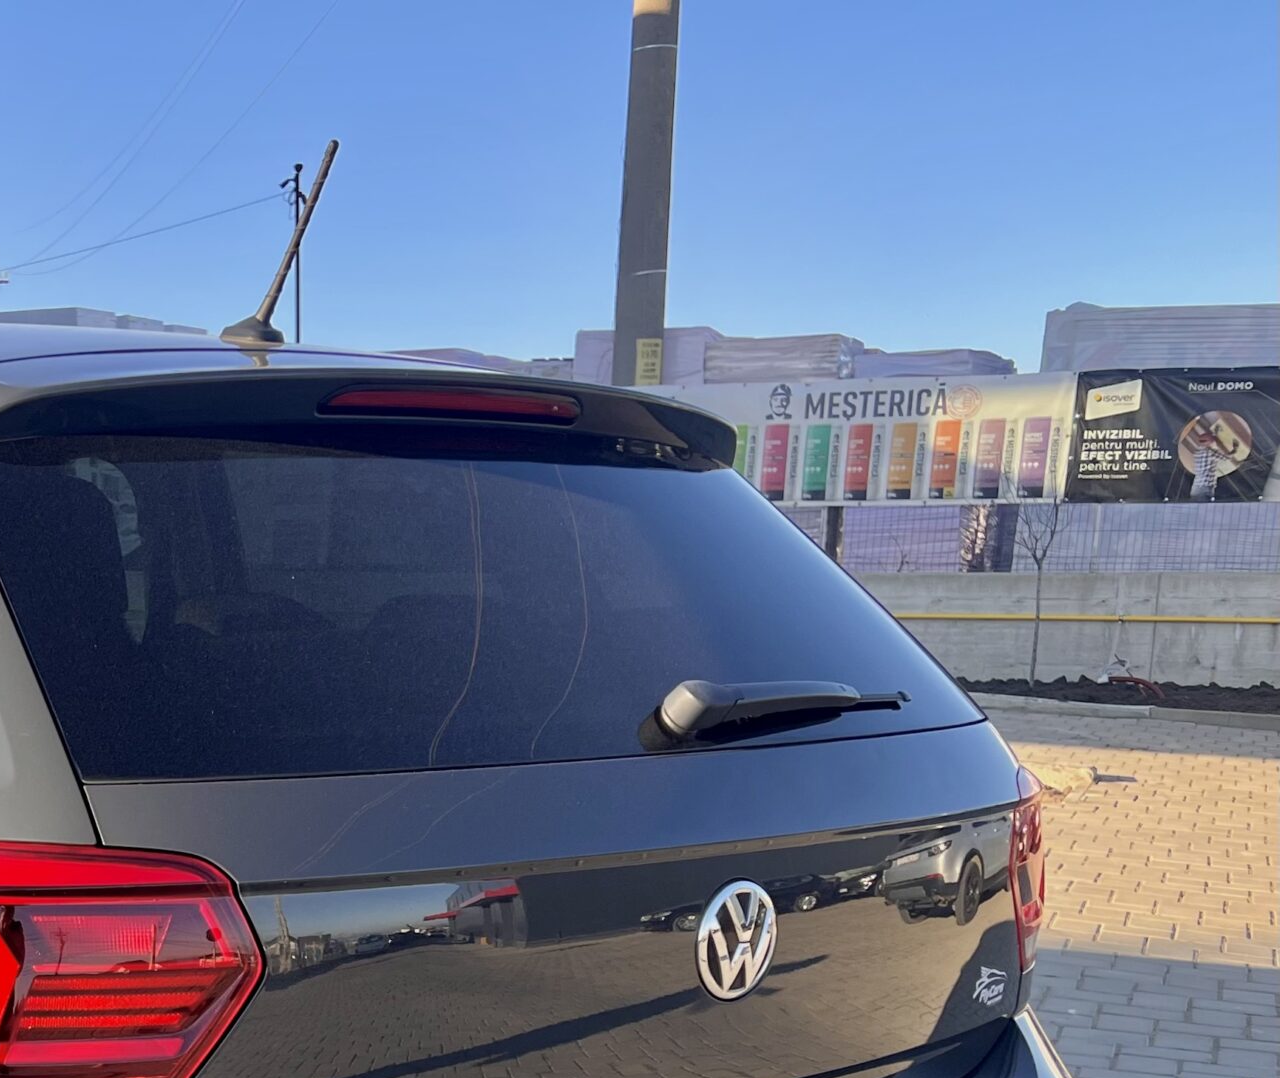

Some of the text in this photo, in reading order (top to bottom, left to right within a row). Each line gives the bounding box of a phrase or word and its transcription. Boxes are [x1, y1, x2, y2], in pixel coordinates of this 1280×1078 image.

[1188, 381, 1254, 391] Noul DOMO
[804, 382, 948, 421] MEȘTERICĂ
[1103, 394, 1135, 402] isover
[1083, 429, 1144, 440] INVIZIBIL
[1081, 440, 1122, 452] pentru
[1080, 450, 1172, 461] EFECT VIZIBIL
[1079, 461, 1120, 472] pentru
